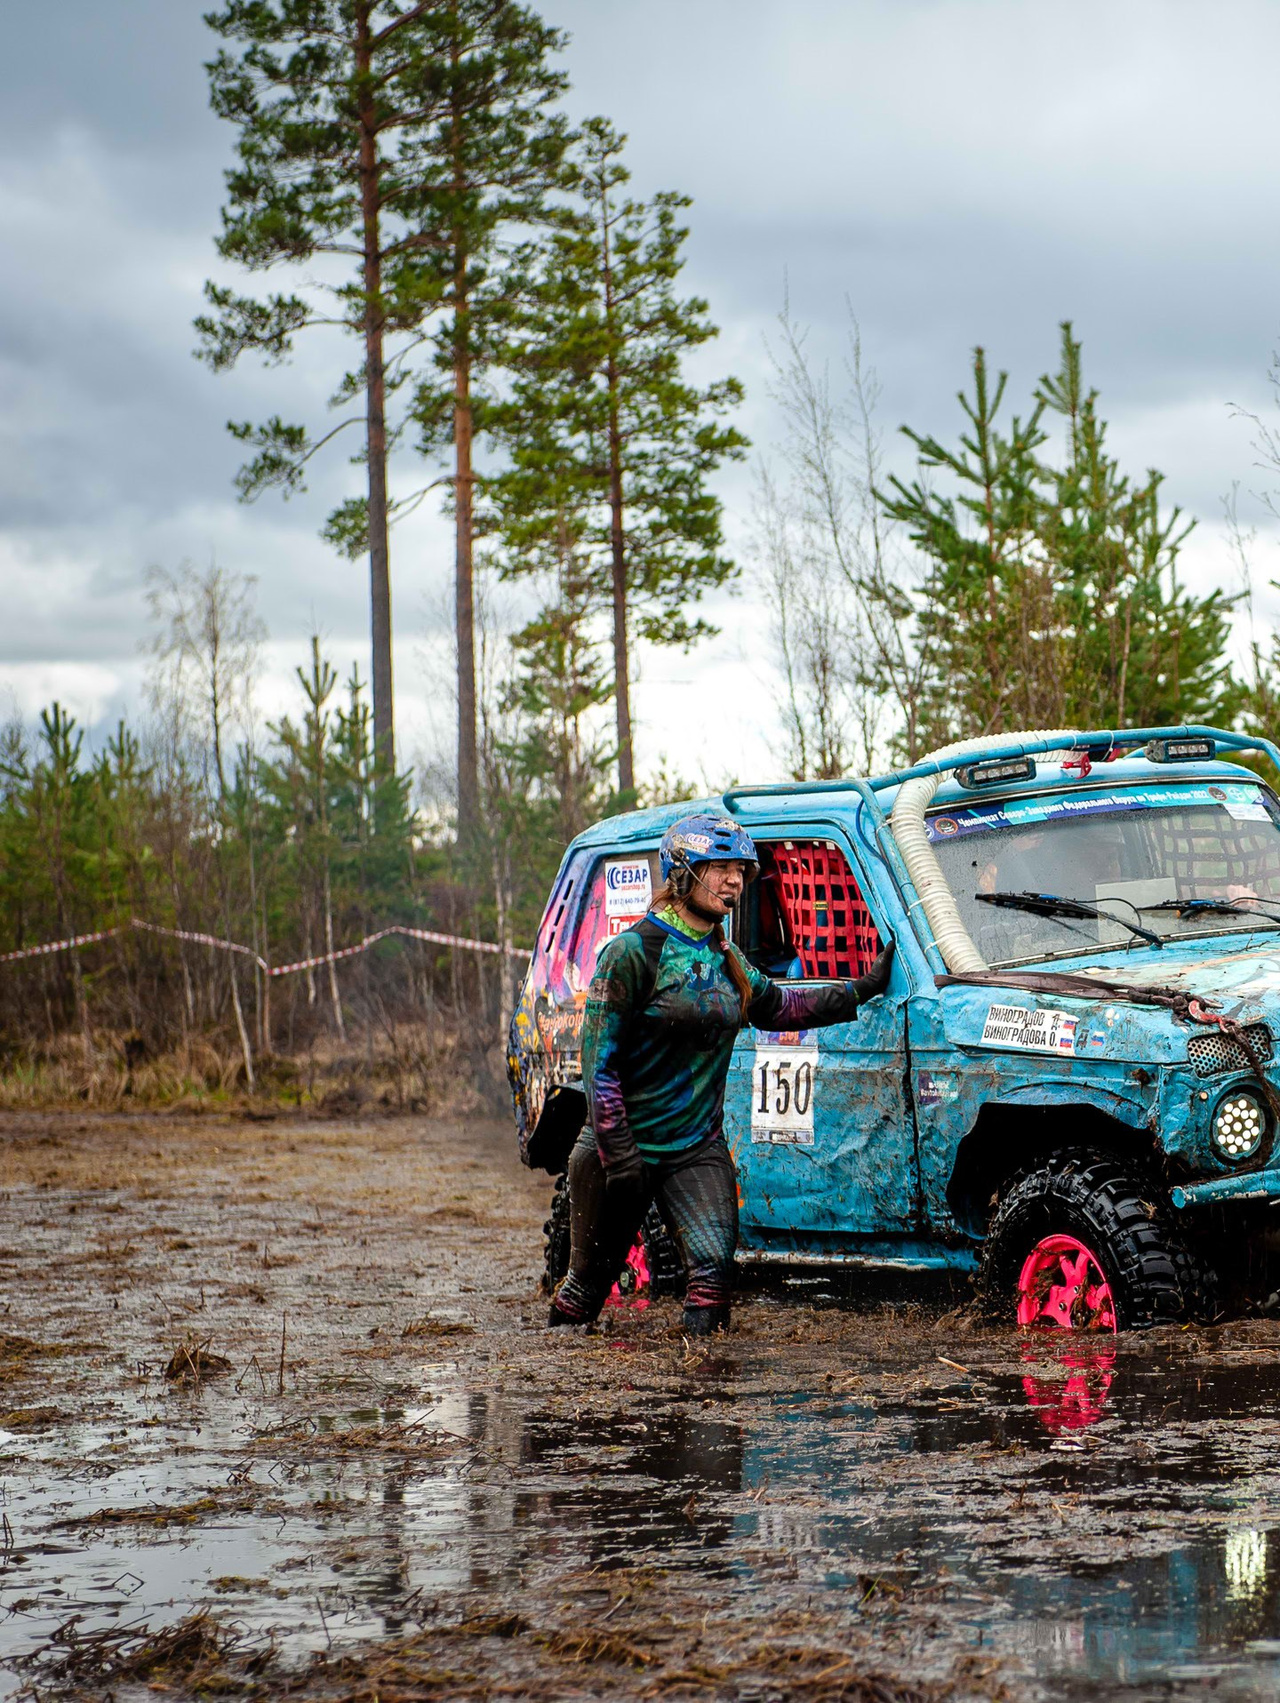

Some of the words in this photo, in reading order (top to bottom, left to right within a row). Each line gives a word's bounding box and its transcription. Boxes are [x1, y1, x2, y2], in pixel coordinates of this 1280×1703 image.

[956, 812, 999, 828] Чемпионат
[999, 801, 1064, 820] Северо-Западного
[1062, 797, 1114, 812] Федерального
[1111, 795, 1137, 806] Округа
[615, 868, 648, 884] СЕЗАР
[988, 1006, 1046, 1028] ВИНОГРАДОВ
[983, 1024, 1047, 1046] ВИНОГРАДОВА
[1049, 1032, 1058, 1047] О.
[758, 1061, 812, 1115] 150
